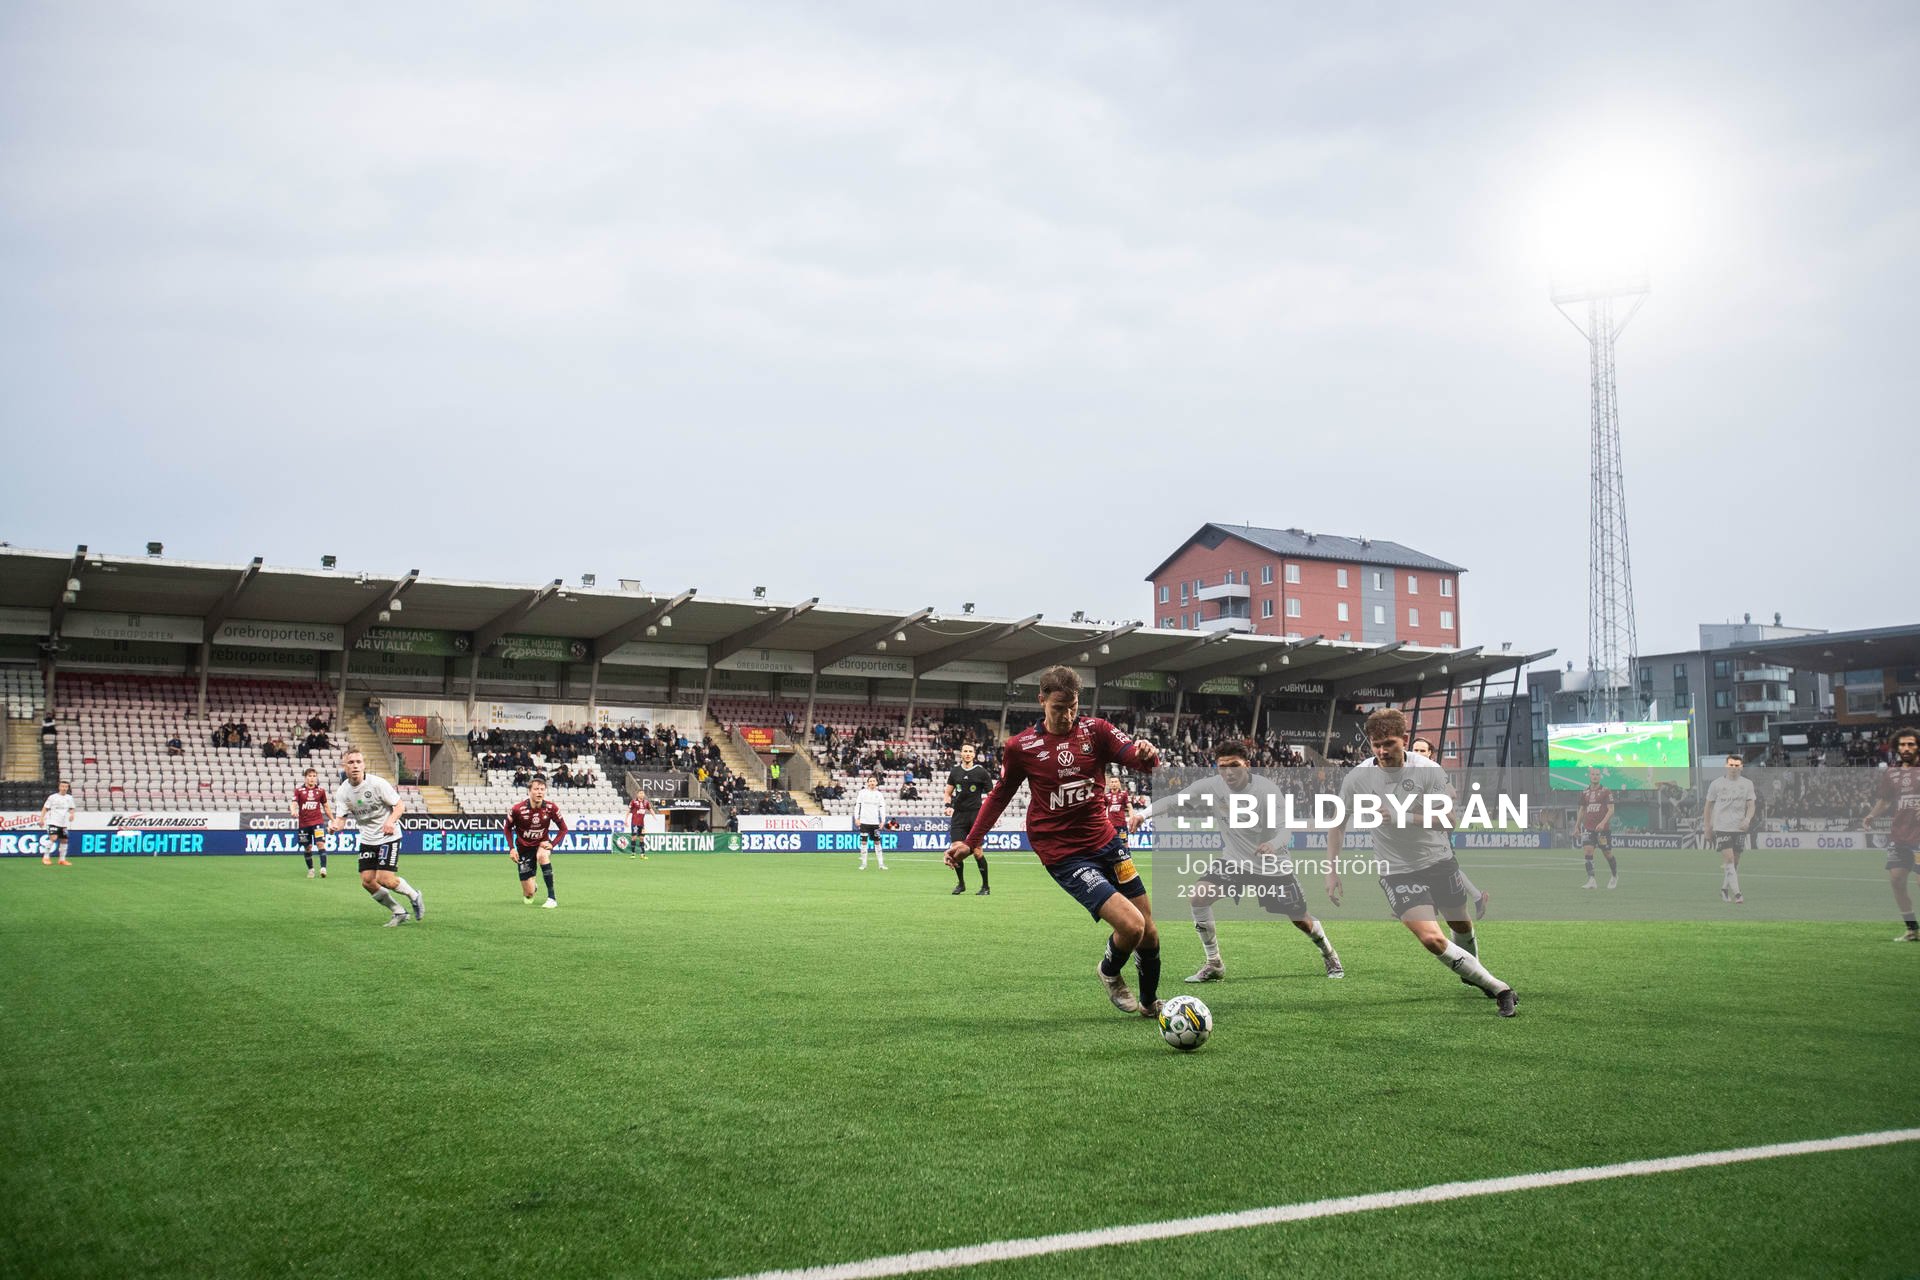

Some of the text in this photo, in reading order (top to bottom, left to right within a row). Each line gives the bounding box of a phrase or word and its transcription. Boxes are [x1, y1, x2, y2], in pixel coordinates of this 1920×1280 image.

[223, 624, 336, 642] örebroporten.se
[1897, 691, 1920, 715] VÄ
[637, 778, 682, 791] RNST
[1050, 778, 1096, 811] NTEX
[249, 815, 300, 830] coloram
[397, 818, 507, 830] NORDICWELLN
[925, 820, 949, 831] Beds
[81, 833, 204, 853] BE BRIGHTER
[422, 834, 442, 851] BE
[644, 834, 715, 851] SUPERETTAN
[817, 834, 833, 850] BE
[1765, 834, 1801, 848] ÖBAB
[1817, 834, 1854, 848] ÖBAB
